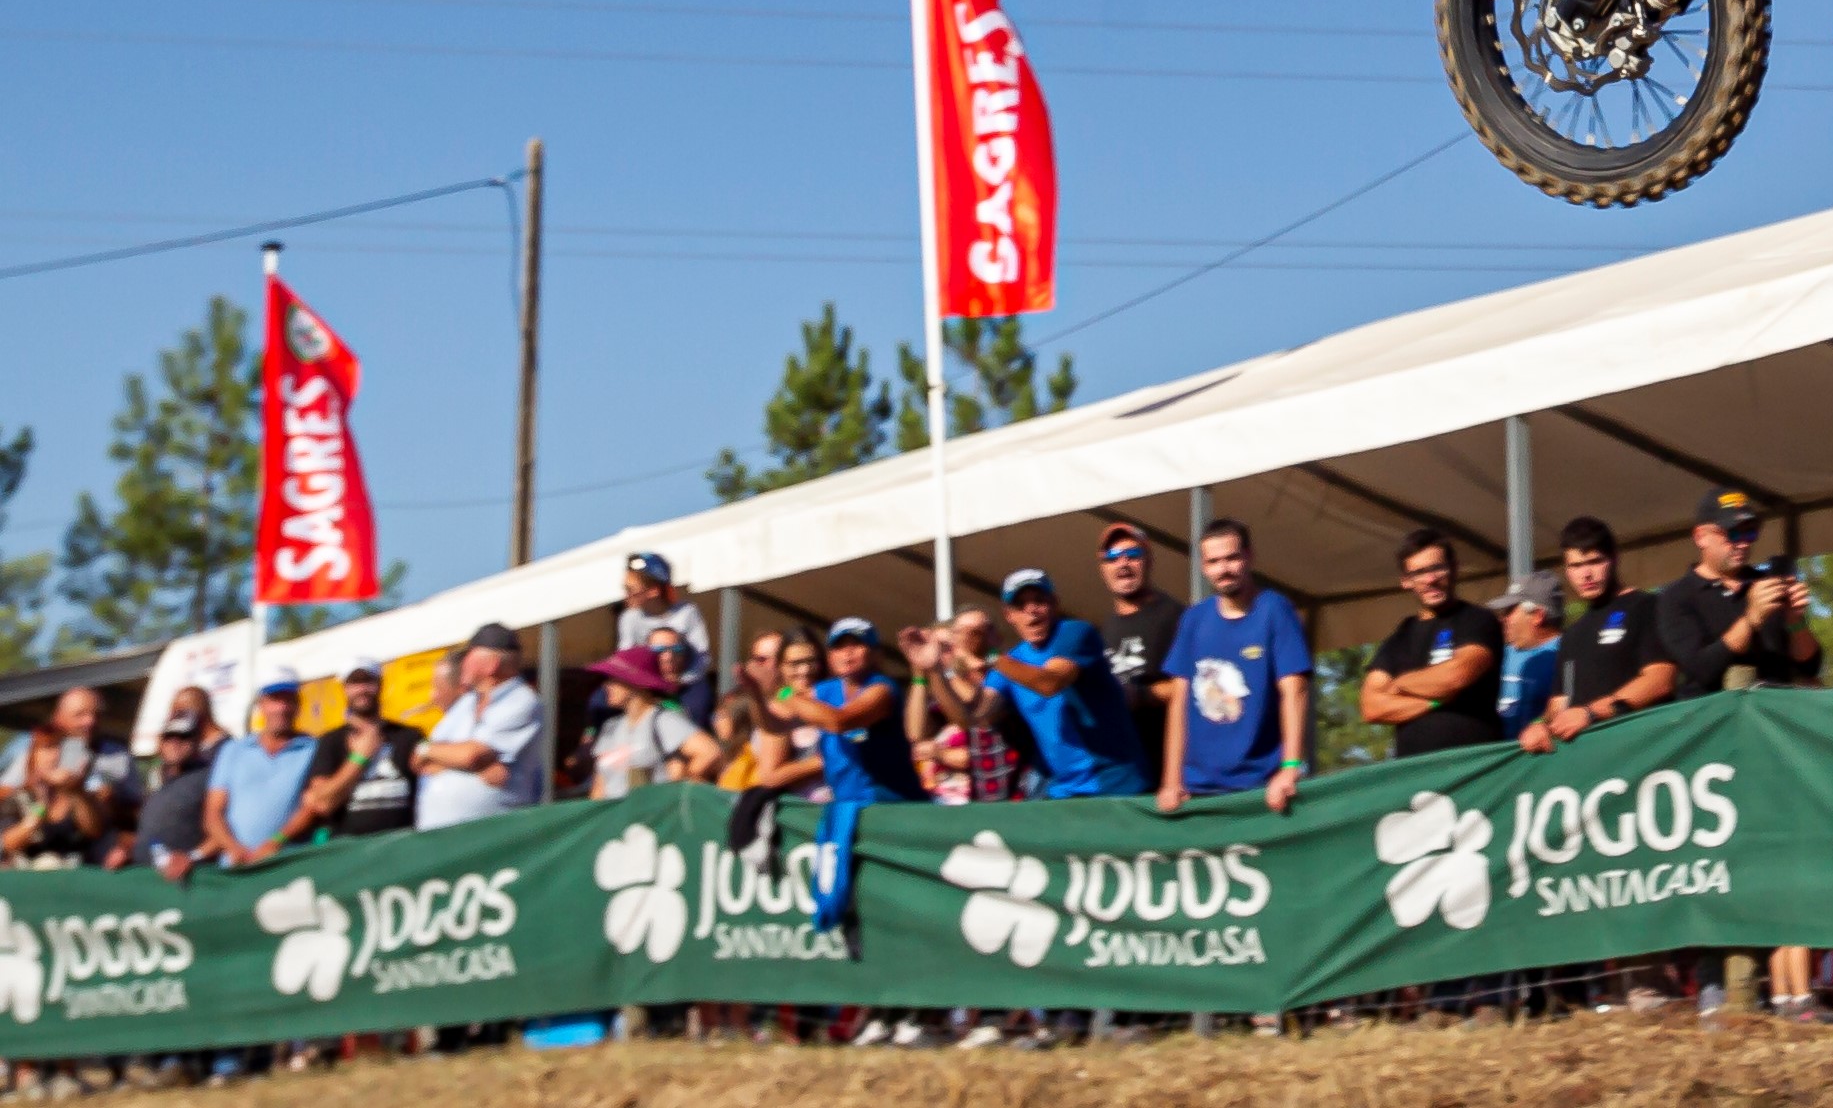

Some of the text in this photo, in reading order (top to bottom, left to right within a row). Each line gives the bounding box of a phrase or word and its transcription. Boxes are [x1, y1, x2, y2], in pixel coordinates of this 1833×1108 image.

[273, 372, 352, 583] SAGRES
[1508, 764, 1738, 898] JOGOS
[351, 867, 519, 978] JOGOS
[1064, 844, 1272, 947] JOGOS
[44, 908, 194, 1002] JOGOS
